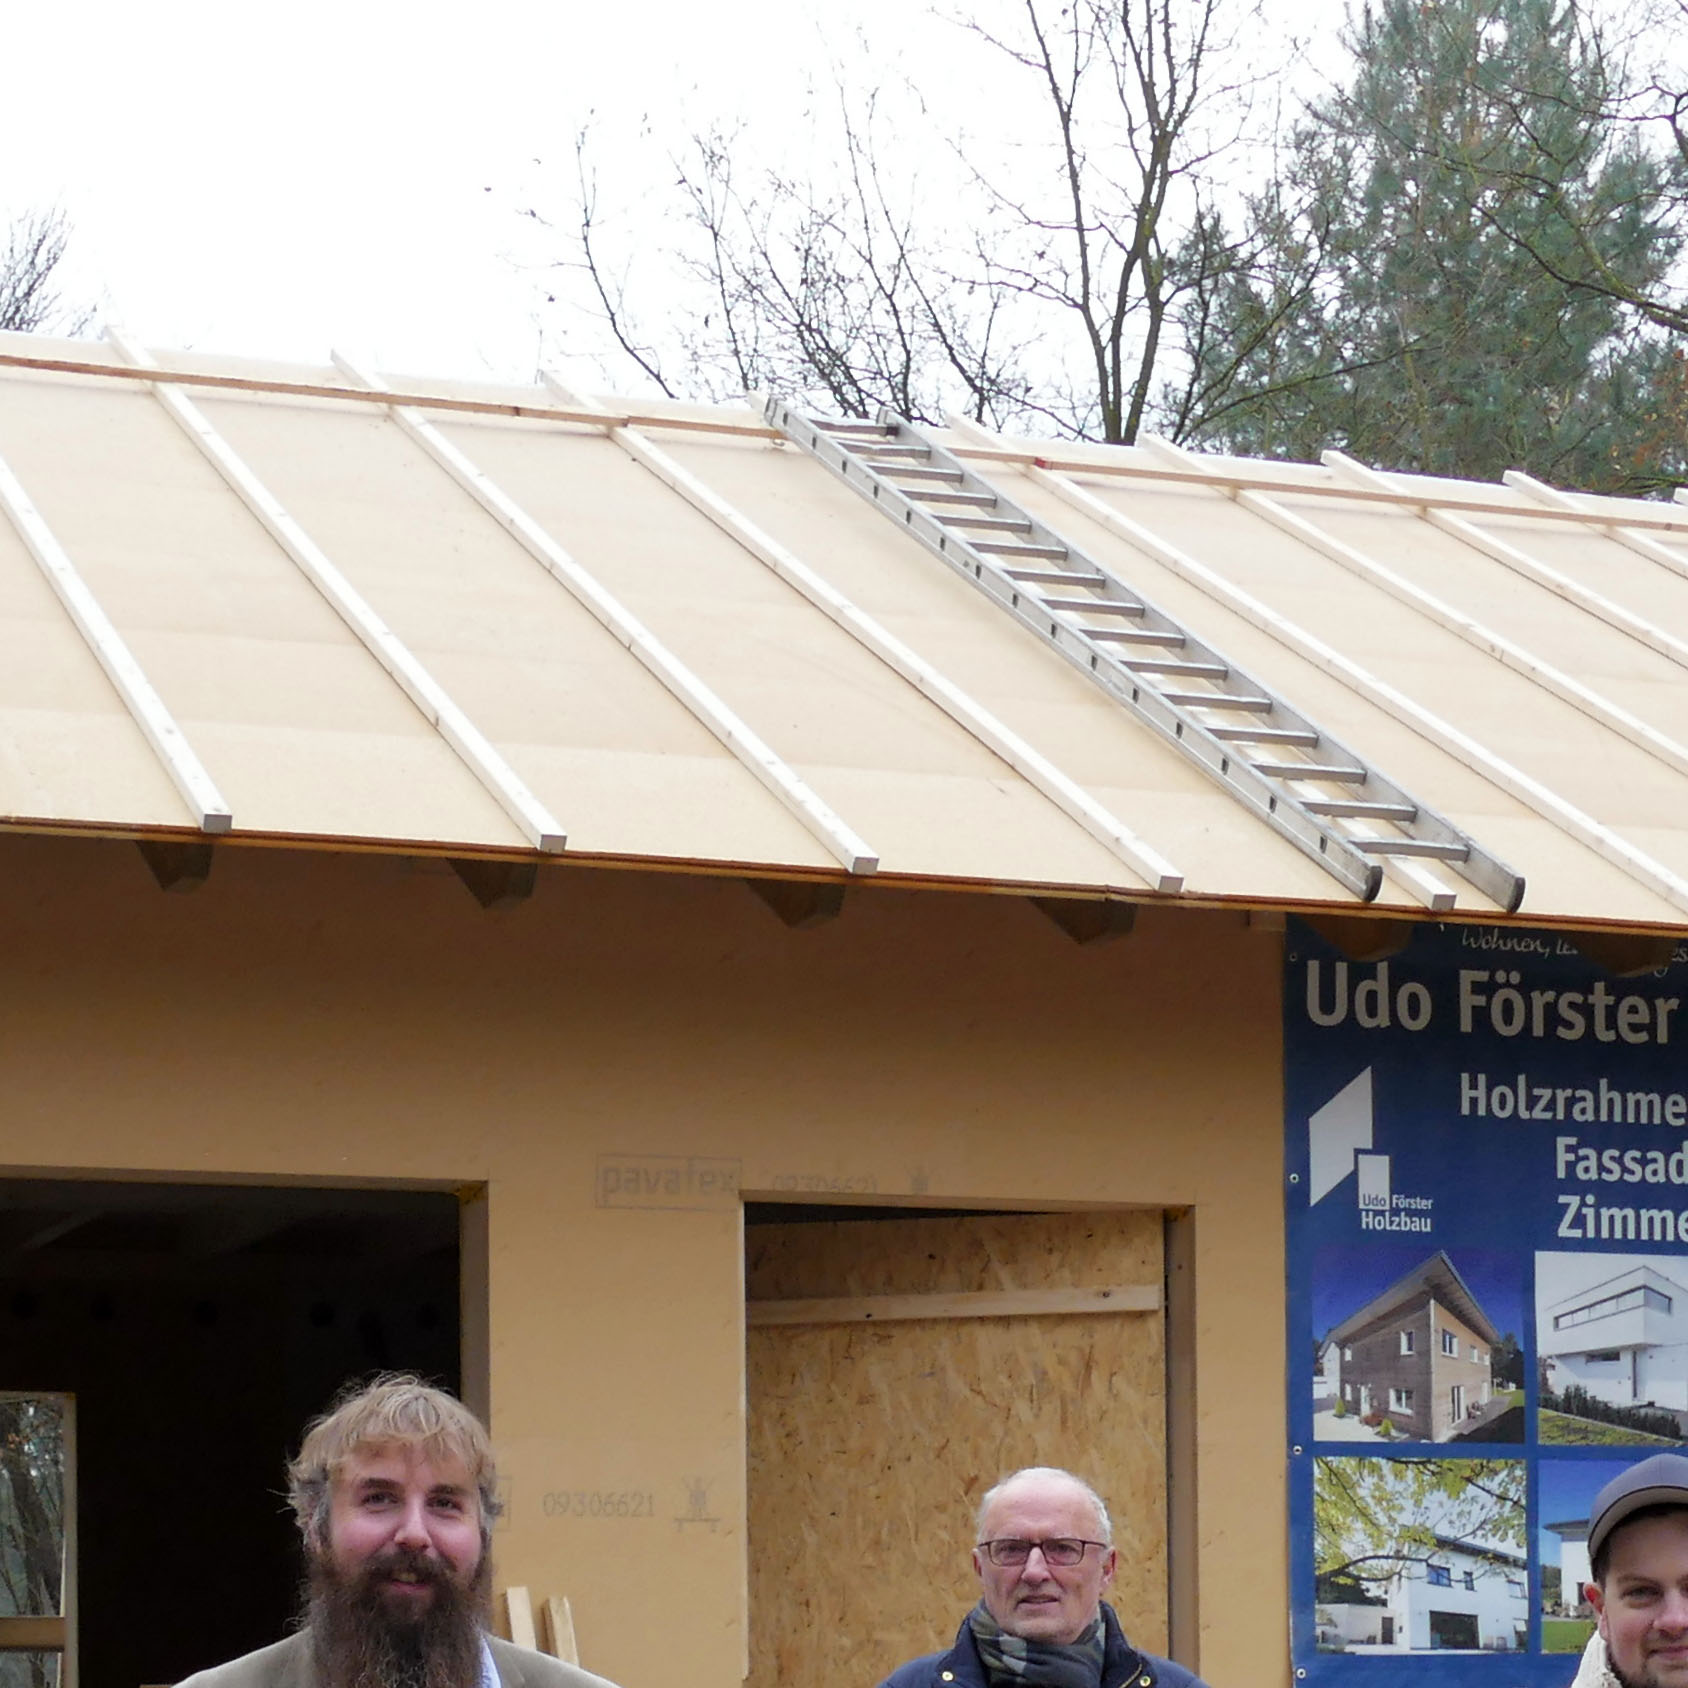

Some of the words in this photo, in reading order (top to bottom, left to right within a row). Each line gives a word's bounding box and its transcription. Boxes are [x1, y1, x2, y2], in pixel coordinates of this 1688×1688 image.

[1307, 960, 1432, 1031] Udo
[1460, 970, 1679, 1045] Förster
[603, 1159, 736, 1204] pavatex
[1363, 1192, 1387, 1207] Udo
[1392, 1194, 1433, 1209] Förster
[1361, 1211, 1432, 1232] Holzbau
[543, 1490, 655, 1518] 09306621
